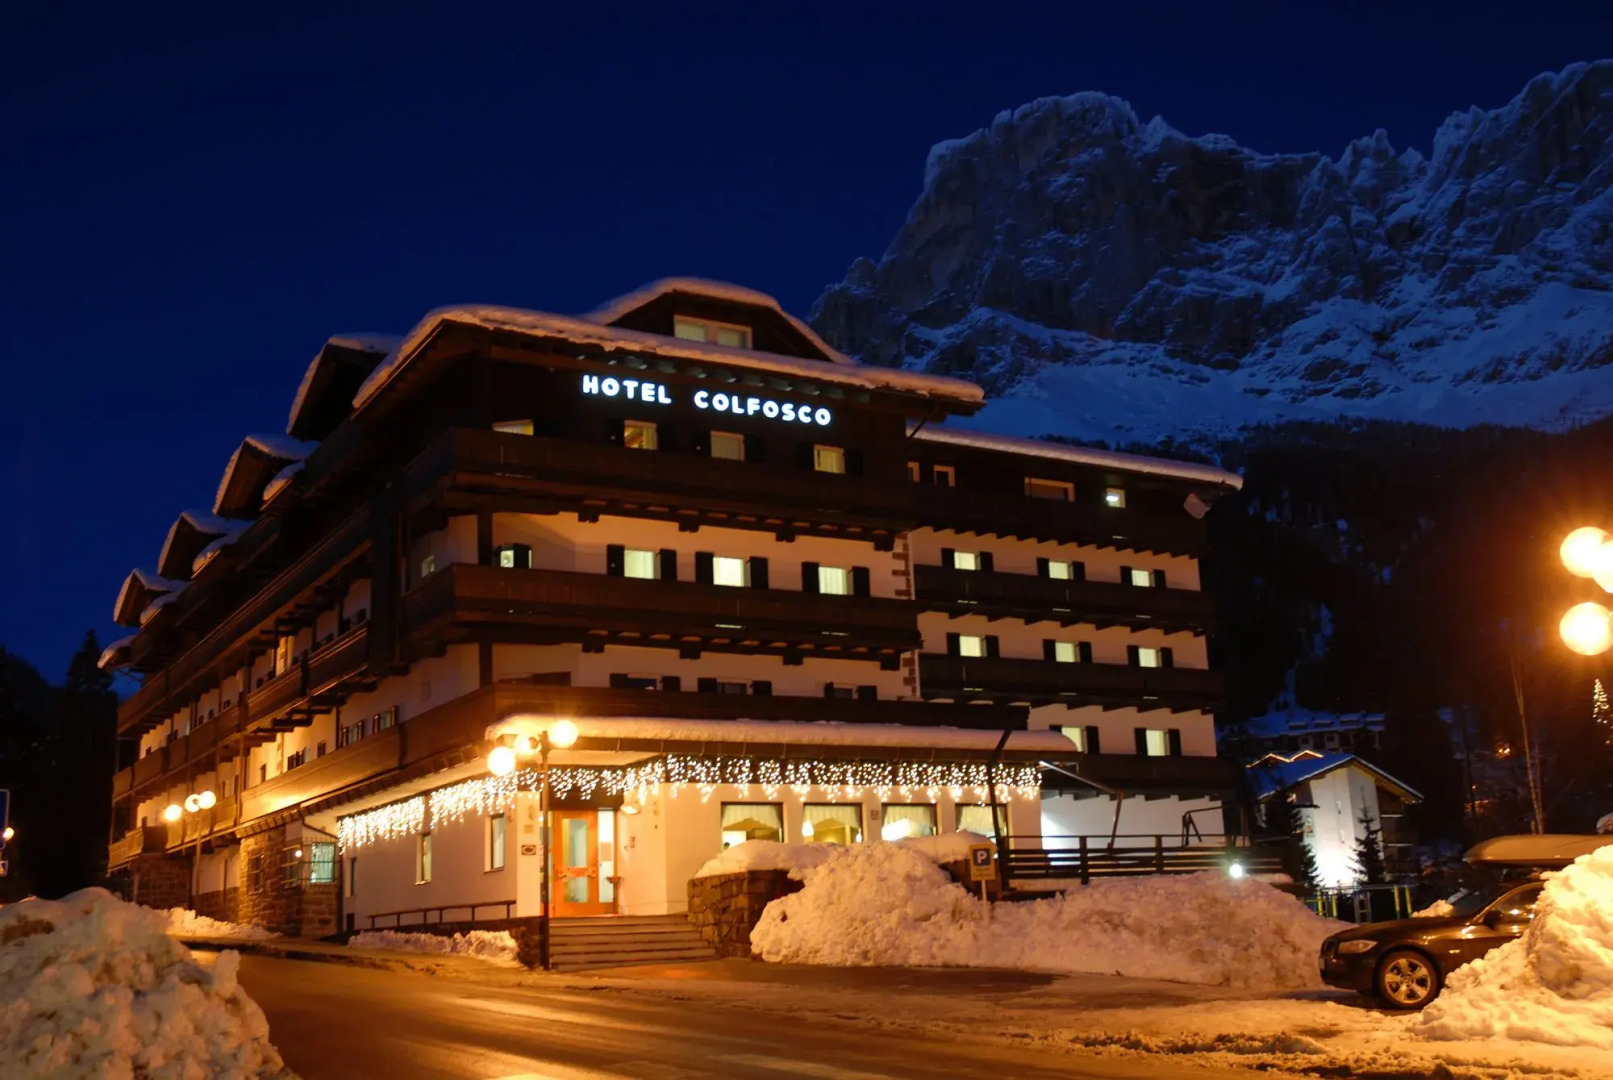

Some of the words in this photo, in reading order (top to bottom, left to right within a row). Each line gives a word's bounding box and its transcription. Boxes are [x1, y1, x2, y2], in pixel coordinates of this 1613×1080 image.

[582, 374, 672, 405] HOTEL
[693, 390, 832, 426] COLFOSCO
[977, 850, 988, 864] P
